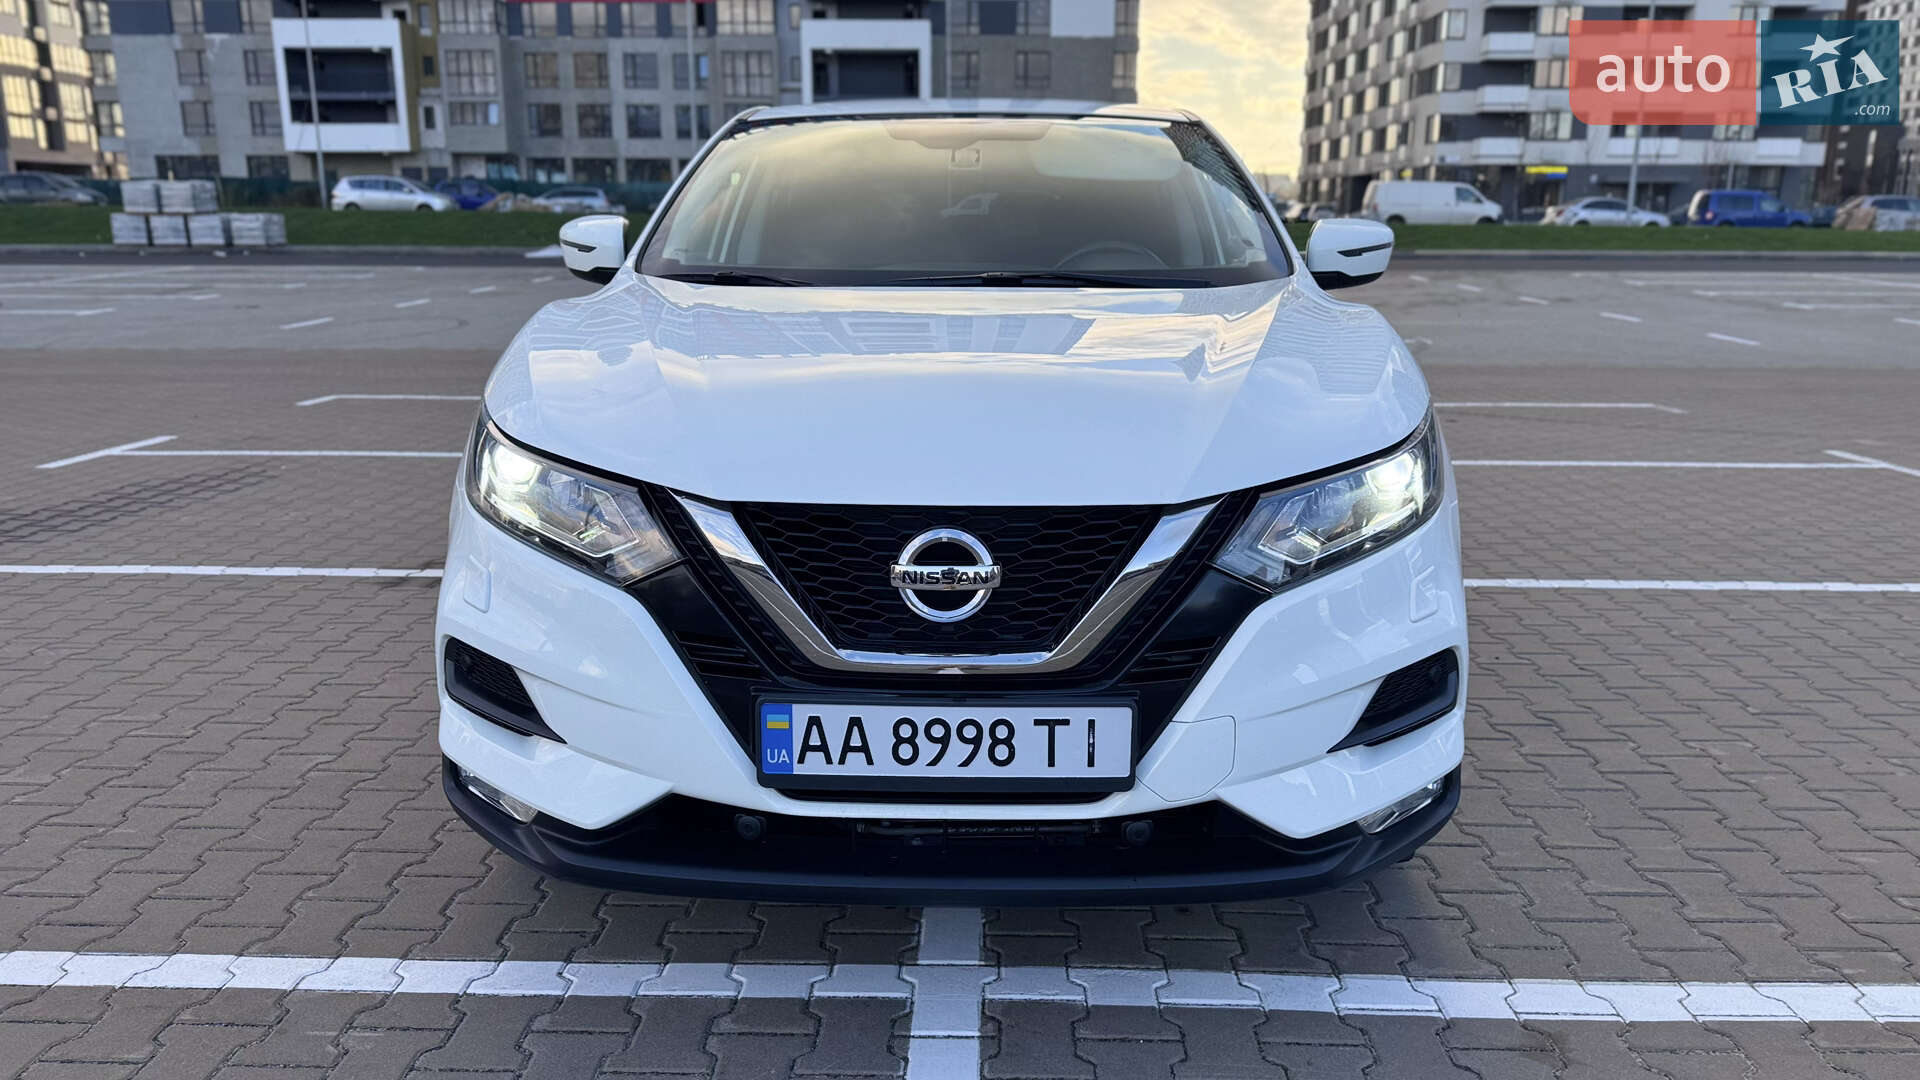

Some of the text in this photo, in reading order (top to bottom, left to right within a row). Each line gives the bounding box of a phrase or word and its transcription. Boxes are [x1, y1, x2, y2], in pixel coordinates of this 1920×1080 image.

[902, 570, 989, 585] NISSAN
[796, 715, 1096, 768] AA 8998 TI
[767, 748, 790, 763] UA
